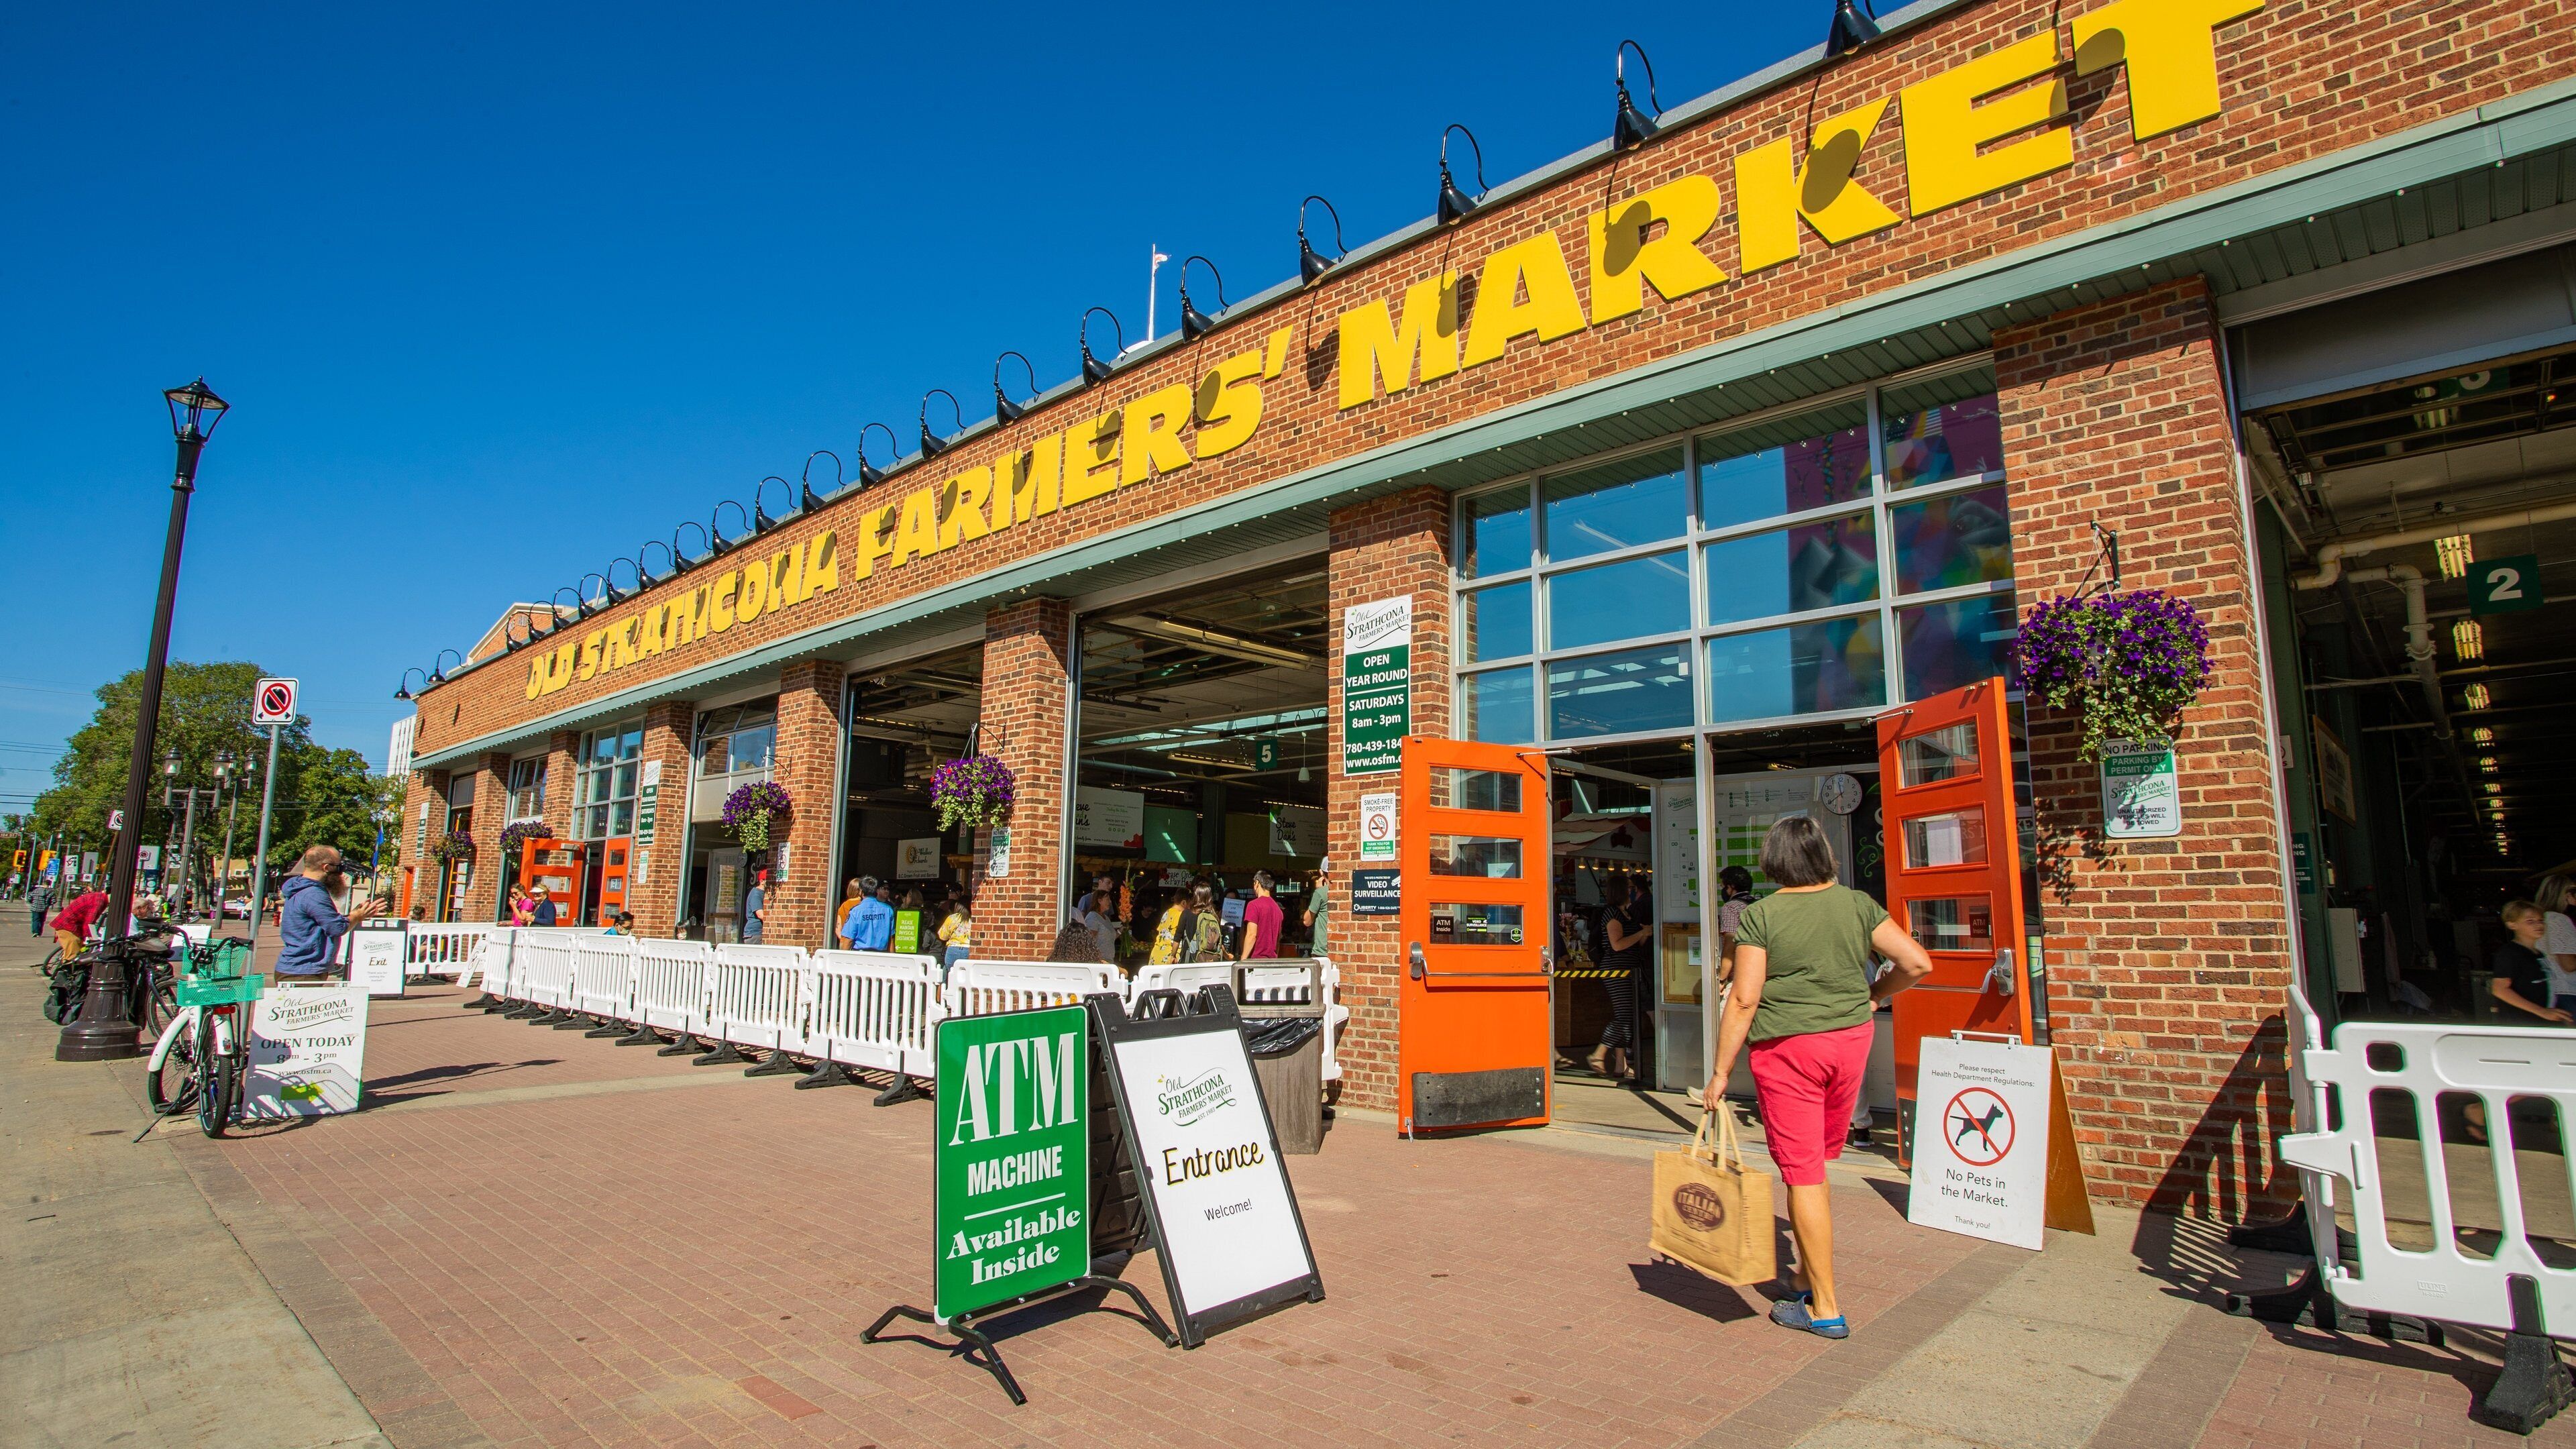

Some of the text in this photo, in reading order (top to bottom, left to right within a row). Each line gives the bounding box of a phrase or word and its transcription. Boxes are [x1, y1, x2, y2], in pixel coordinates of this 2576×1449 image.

[526, 0, 2264, 700] OLD STRATHCONA FARMERS' MARKET
[2487, 568, 2522, 602] 2
[1346, 606, 1404, 639] STRATHCONA
[1356, 610, 1370, 623] Old
[1358, 613, 1410, 641] FARMERS' MARKET
[1363, 653, 1390, 667] OPEN
[1346, 668, 1408, 688] YEAR ROUND
[1349, 694, 1405, 712] SATURDAYS
[1352, 718, 1372, 728] 8am
[1379, 714, 1401, 727] 3pm
[1262, 744, 1272, 763] 5
[1346, 738, 1401, 754] 780-439-184
[2106, 743, 2167, 754] NO PARKING
[1346, 753, 1401, 768] www.osfm.c
[2112, 757, 2149, 765] PARKING
[2111, 764, 2166, 774] PERMIT ONLY
[2110, 780, 2165, 798] STRATHCONA
[2148, 786, 2171, 794] MARKET
[1276, 817, 1296, 828] Steve
[1277, 829, 1296, 841] Dan's
[1170, 877, 1181, 886] Pay
[862, 913, 886, 921] SECURITY
[369, 957, 387, 966] Exit
[268, 999, 347, 1021] STRATHCONA
[284, 998, 303, 1008] Old
[286, 1007, 354, 1024] FARMERS' MARKET
[261, 1036, 356, 1049] OPEN TODAY
[276, 1054, 299, 1064] 8am
[314, 1053, 337, 1063] 3pm
[279, 1068, 332, 1076] www.osfm.ca
[1981, 1067, 2005, 1075] respect
[1166, 1077, 1184, 1093] Old
[1953, 1072, 1991, 1082] Department
[1994, 1077, 2035, 1087] Regulations:
[949, 1032, 1078, 1146] ATM
[1159, 1074, 1224, 1115] STRATHCONA
[1178, 1085, 1232, 1118] FARMERS' MARKET
[1206, 1108, 1216, 1116] 1983
[968, 1145, 1063, 1197] MACHINE
[1163, 1142, 1265, 1186] Entrance
[1946, 1168, 2005, 1189] No Pets in
[1941, 1185, 2008, 1207] the Market.
[1204, 1199, 1252, 1221] Welcome!
[1678, 1191, 1721, 1218] ITALIAN
[1955, 1216, 1974, 1226] Thank
[946, 1205, 1081, 1260] Available
[971, 1241, 1060, 1285] Inside
